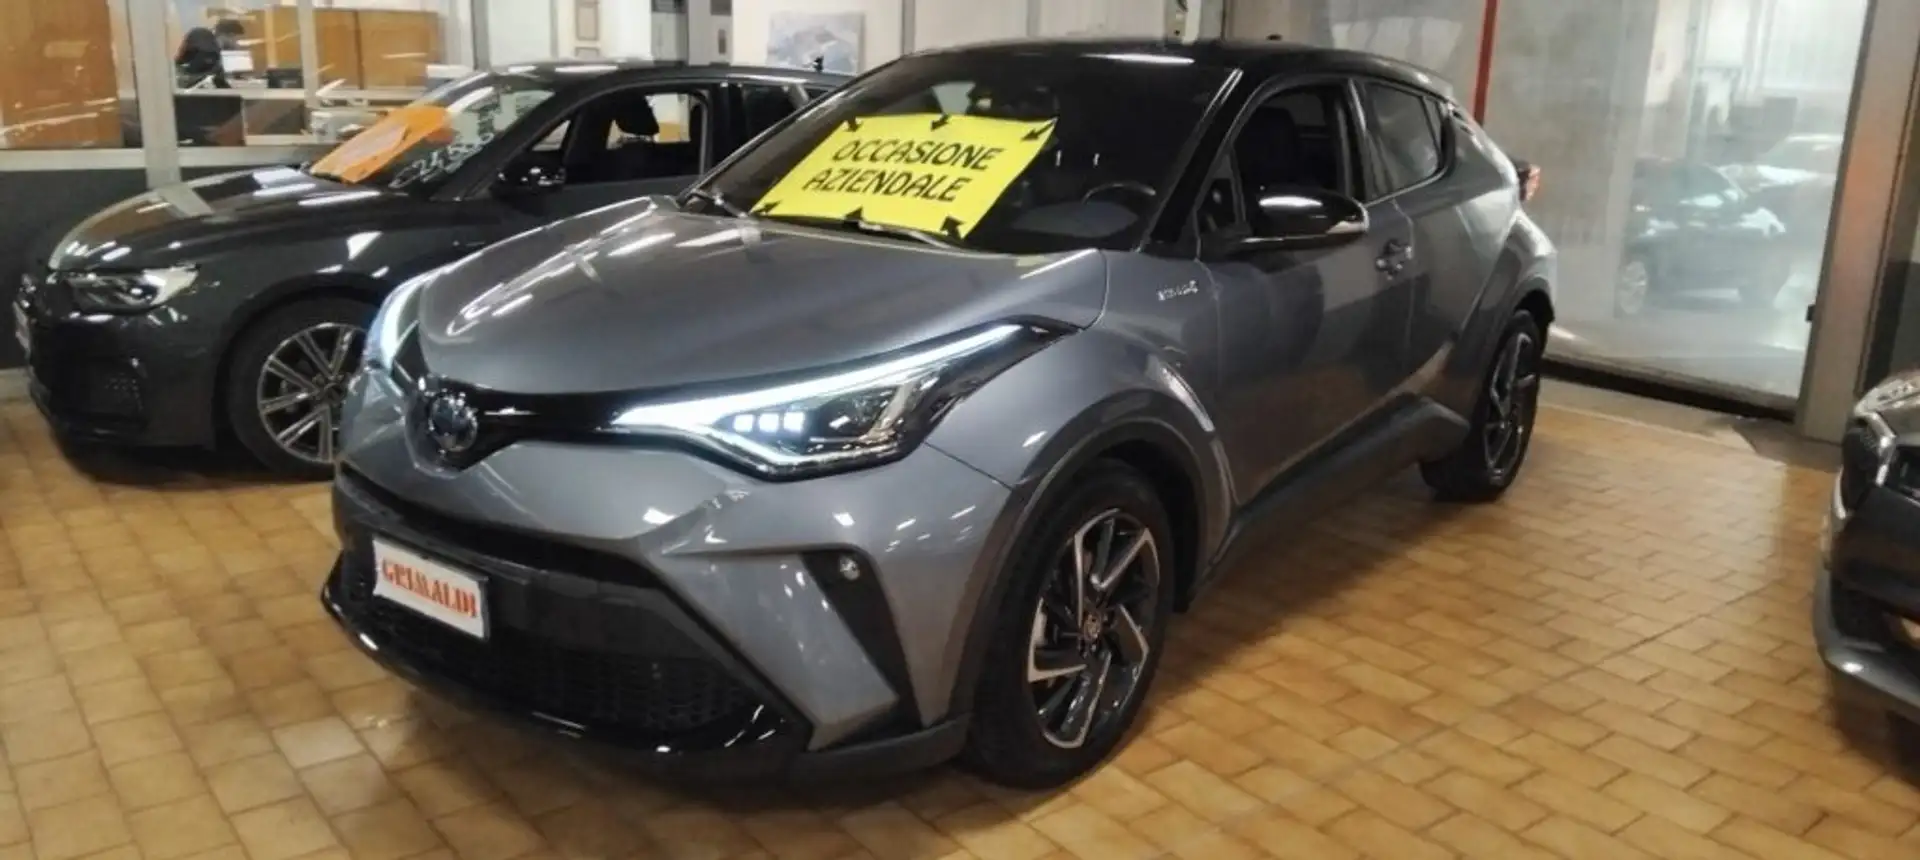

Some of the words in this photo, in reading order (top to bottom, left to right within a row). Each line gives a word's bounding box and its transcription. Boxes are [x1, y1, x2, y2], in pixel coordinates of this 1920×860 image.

[833, 139, 1005, 170] OCCASIONE
[803, 168, 971, 202] AZIENDALE
[383, 558, 477, 617] GRIMALDI
